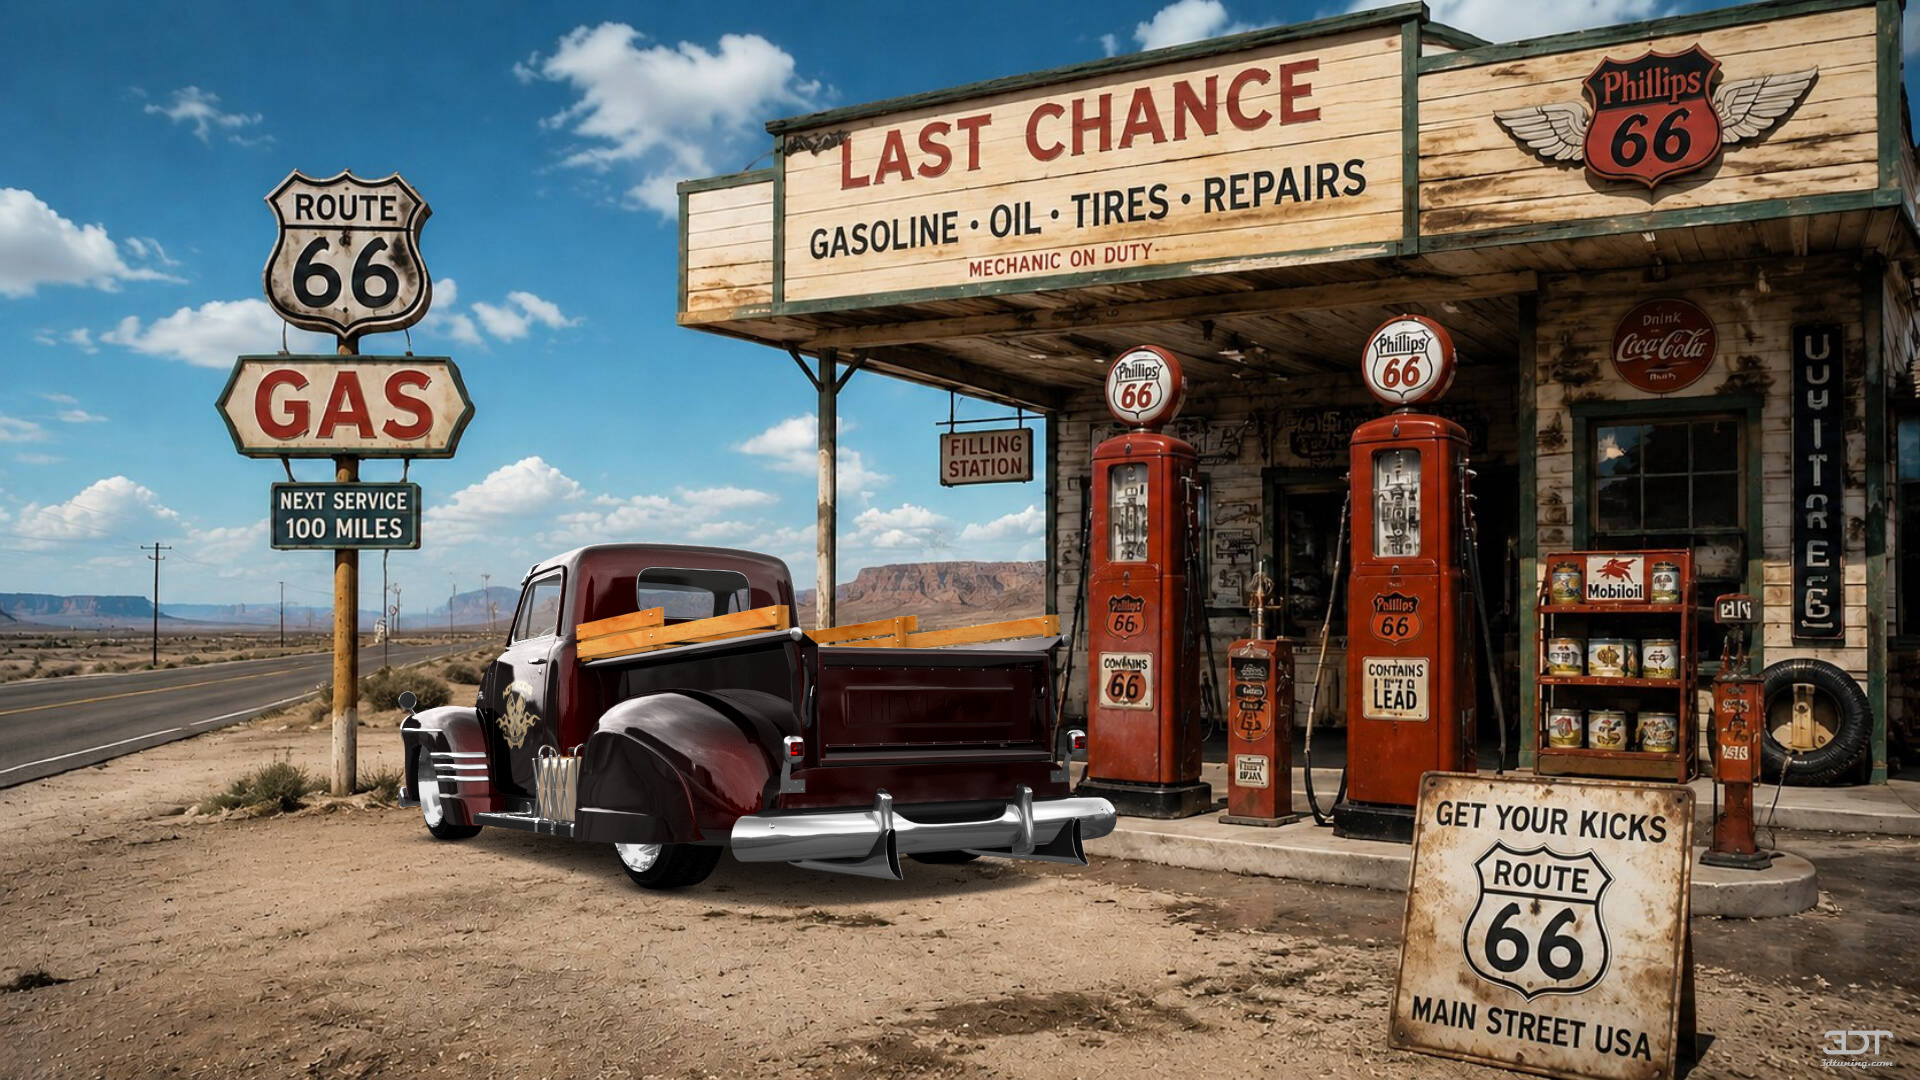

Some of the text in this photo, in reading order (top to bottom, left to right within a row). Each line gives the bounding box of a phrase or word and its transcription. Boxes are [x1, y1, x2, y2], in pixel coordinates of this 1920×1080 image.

[1601, 66, 1702, 108] Phillips
[840, 57, 1323, 191] LAST CHANCE
[1610, 106, 1692, 168] 66
[295, 193, 397, 222] ROUTE
[809, 158, 1367, 261] GASOLINE OIL TIRES REPAIRS
[293, 236, 399, 308] 66
[968, 252, 1063, 278] MECHANIC
[1070, 249, 1097, 267] ON
[1379, 334, 1425, 354] Phillips
[1119, 362, 1158, 380] Phillips
[1383, 356, 1420, 388] 66
[254, 368, 435, 440] GAS
[1121, 382, 1154, 409] 66
[950, 434, 1022, 457] FILLING
[949, 457, 1022, 478] STATION
[280, 491, 407, 511] NEXT SERVICE
[286, 518, 403, 539] 100 MILES
[1588, 584, 1643, 599] Mobiloil
[1114, 615, 1135, 632] 66
[1381, 616, 1409, 636] 66
[1368, 664, 1424, 677] CONTAINS
[1111, 673, 1139, 699] 66
[1374, 689, 1417, 710] LEAD
[1436, 800, 1668, 843] GET YOUR KICKS
[1493, 859, 1589, 894] ROUTE
[1484, 902, 1584, 981] 66
[1411, 995, 1652, 1062] MAIN STREET USA
